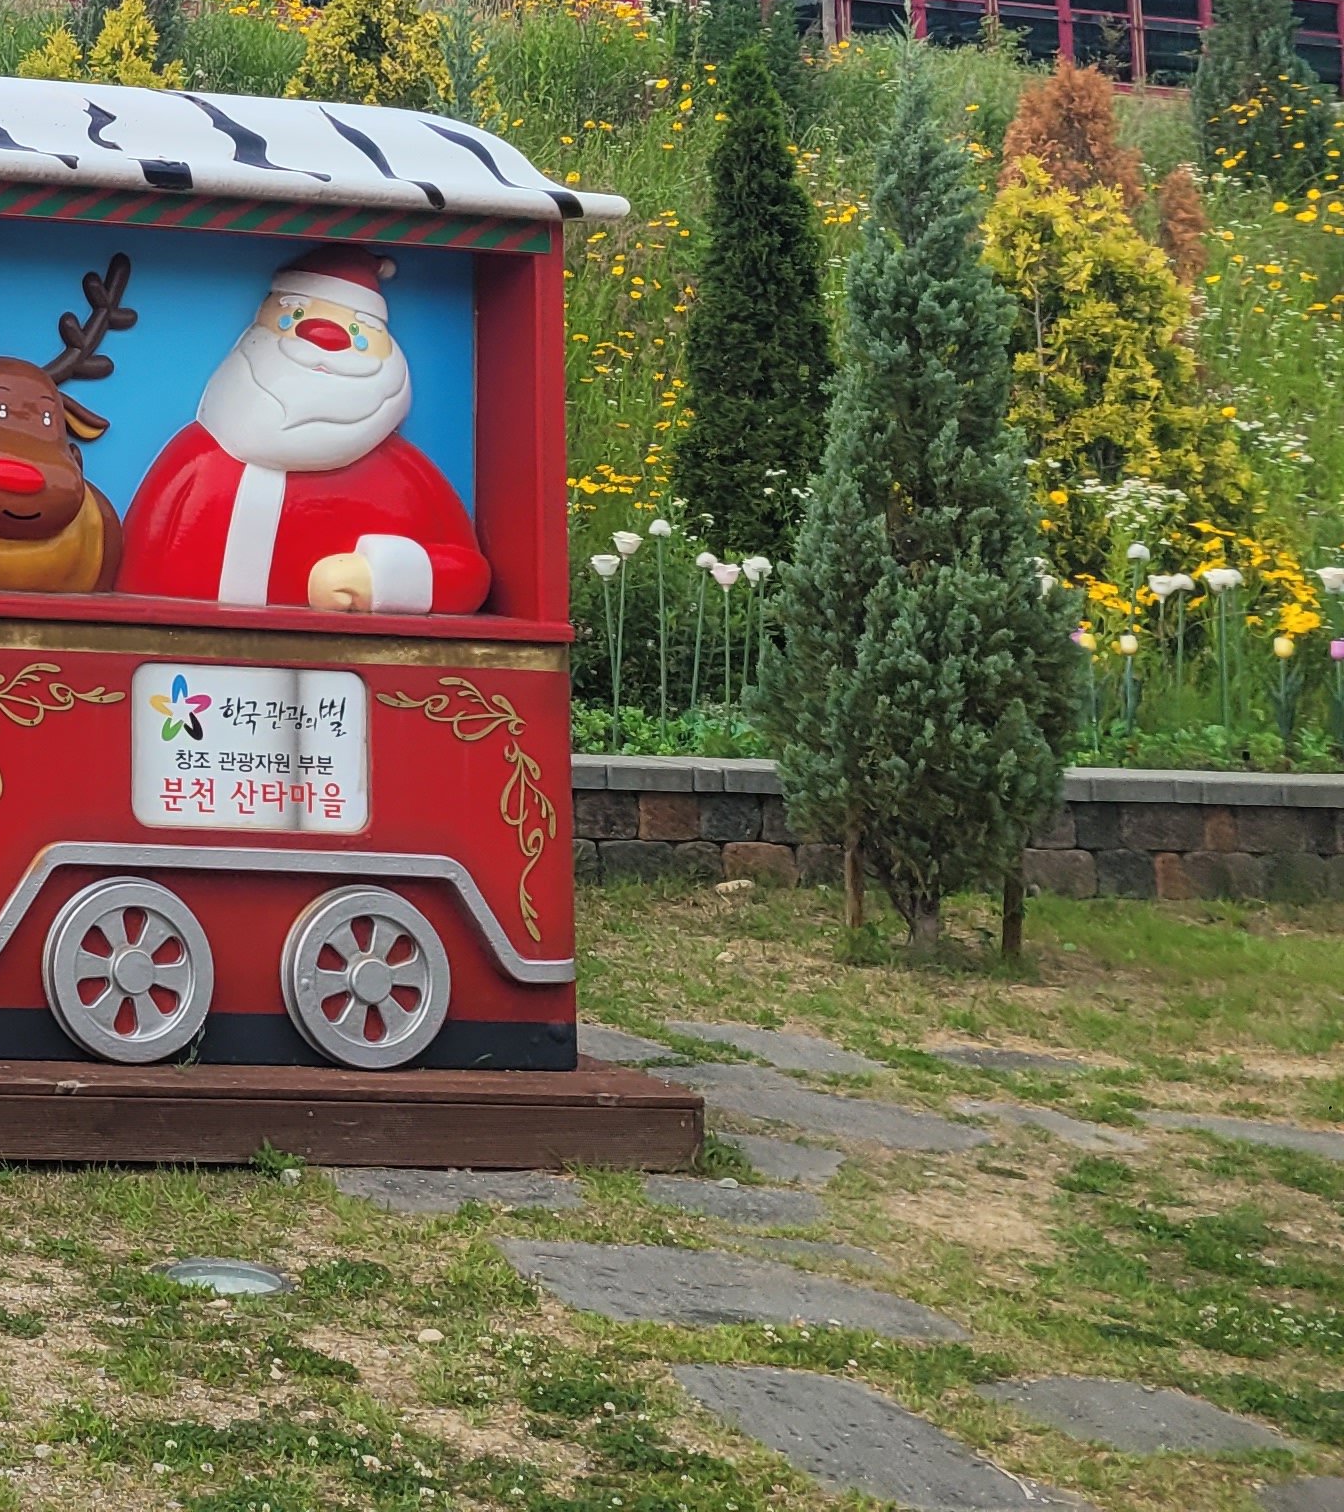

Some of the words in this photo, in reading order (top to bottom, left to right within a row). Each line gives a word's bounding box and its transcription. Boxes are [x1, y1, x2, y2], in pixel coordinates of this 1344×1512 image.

[219, 696, 261, 736] 한국
[264, 700, 318, 732] 관광의
[318, 696, 348, 737] 별
[175, 749, 212, 771] 창조
[217, 751, 292, 774] 관광자원
[297, 754, 335, 776] 부분
[159, 777, 217, 814] 분천
[230, 779, 347, 819] 산타마을
